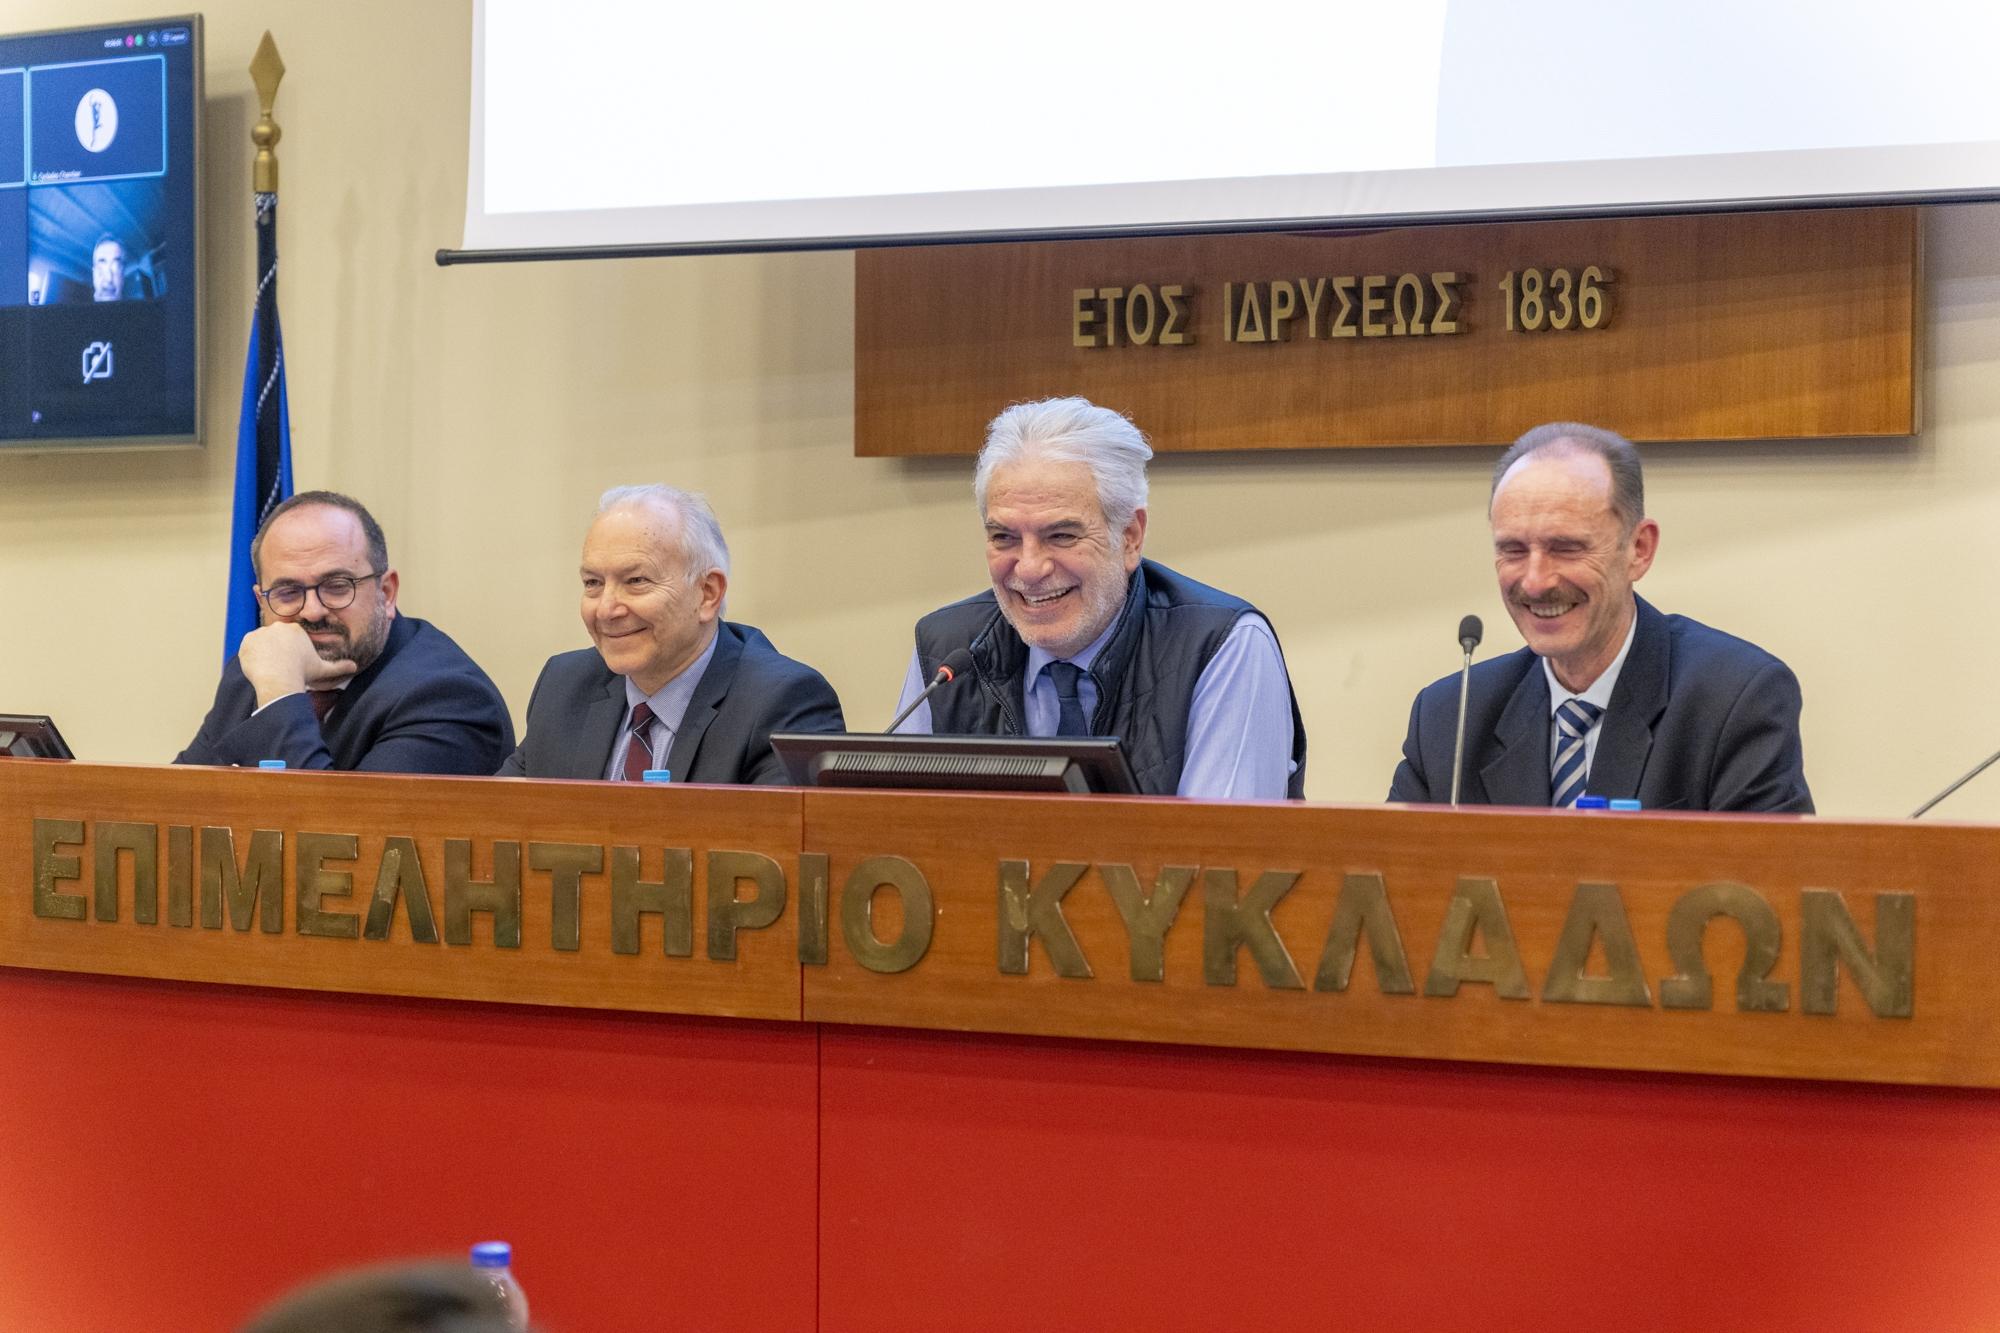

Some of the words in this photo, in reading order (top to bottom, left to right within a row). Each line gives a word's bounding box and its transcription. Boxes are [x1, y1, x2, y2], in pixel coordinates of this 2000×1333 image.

[1073, 284, 1187, 348] ΕΤΟΣ
[1224, 271, 1459, 342] ΙΔΡΥΣΕΩΣ
[1499, 265, 1605, 332] 1836
[33, 818, 936, 974] ΕΠΙΜΕΛΗΤΗΡΙΟ
[999, 859, 1916, 1018] ΚΥΚΛΑΔΩΝ
